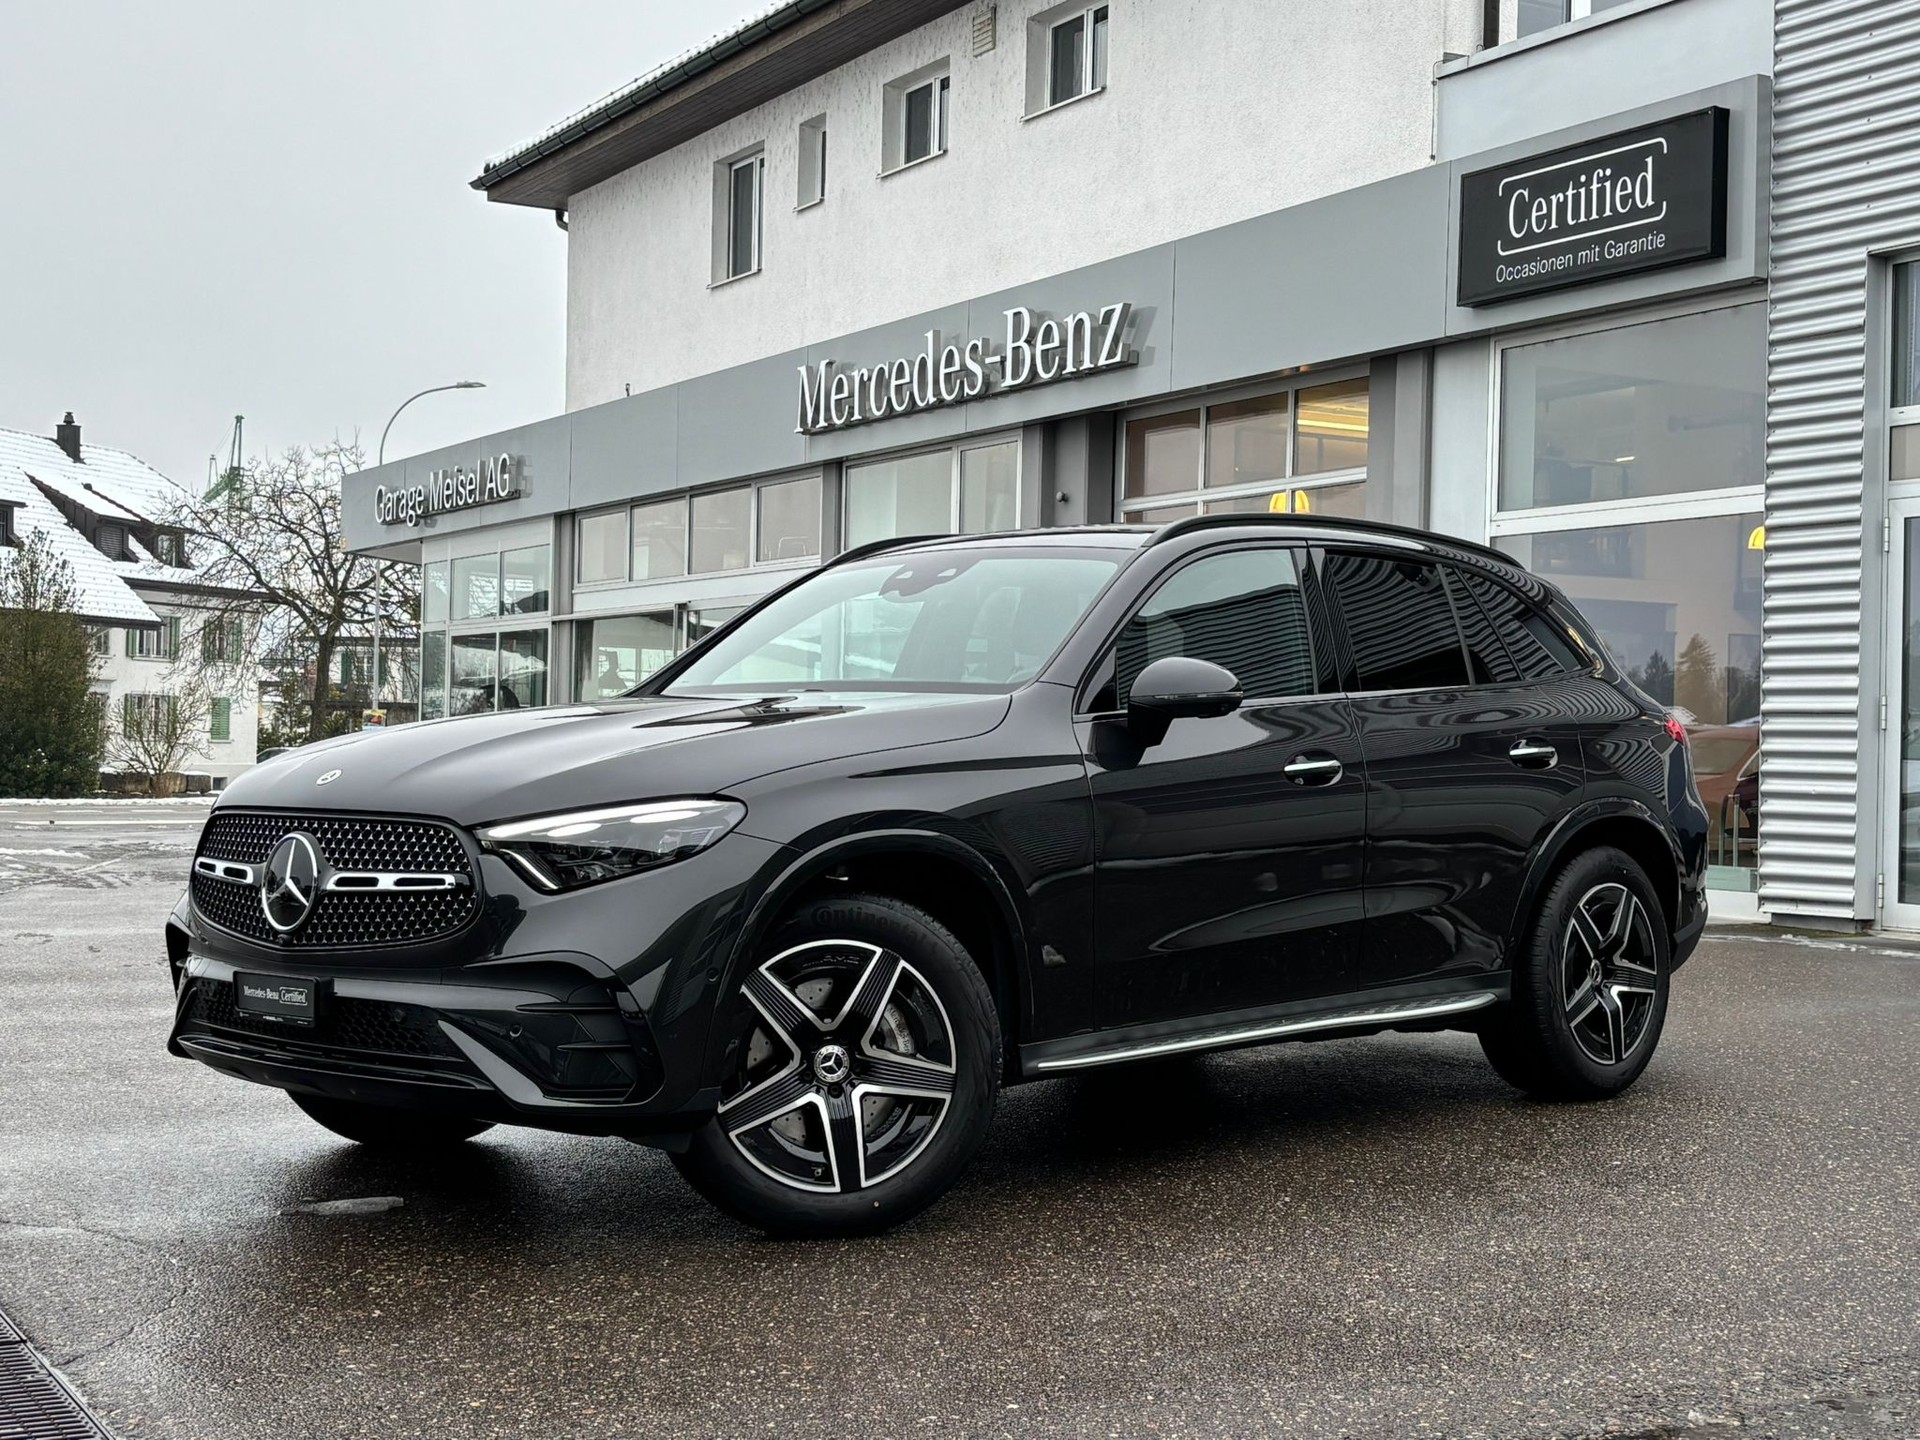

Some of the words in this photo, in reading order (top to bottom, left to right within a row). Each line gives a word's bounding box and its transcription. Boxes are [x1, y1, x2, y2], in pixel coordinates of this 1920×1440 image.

[1508, 155, 1655, 239] Certified
[1496, 254, 1573, 283] Occasionen
[1577, 244, 1600, 266] mit
[1604, 230, 1666, 260] Garantie
[794, 302, 1134, 434] Mercedes-Benz
[374, 484, 425, 527] Garage
[429, 459, 481, 512] Meisel
[484, 452, 511, 500] AG
[243, 985, 280, 1000] Mercedes-Benz
[281, 990, 306, 1003] Certified
